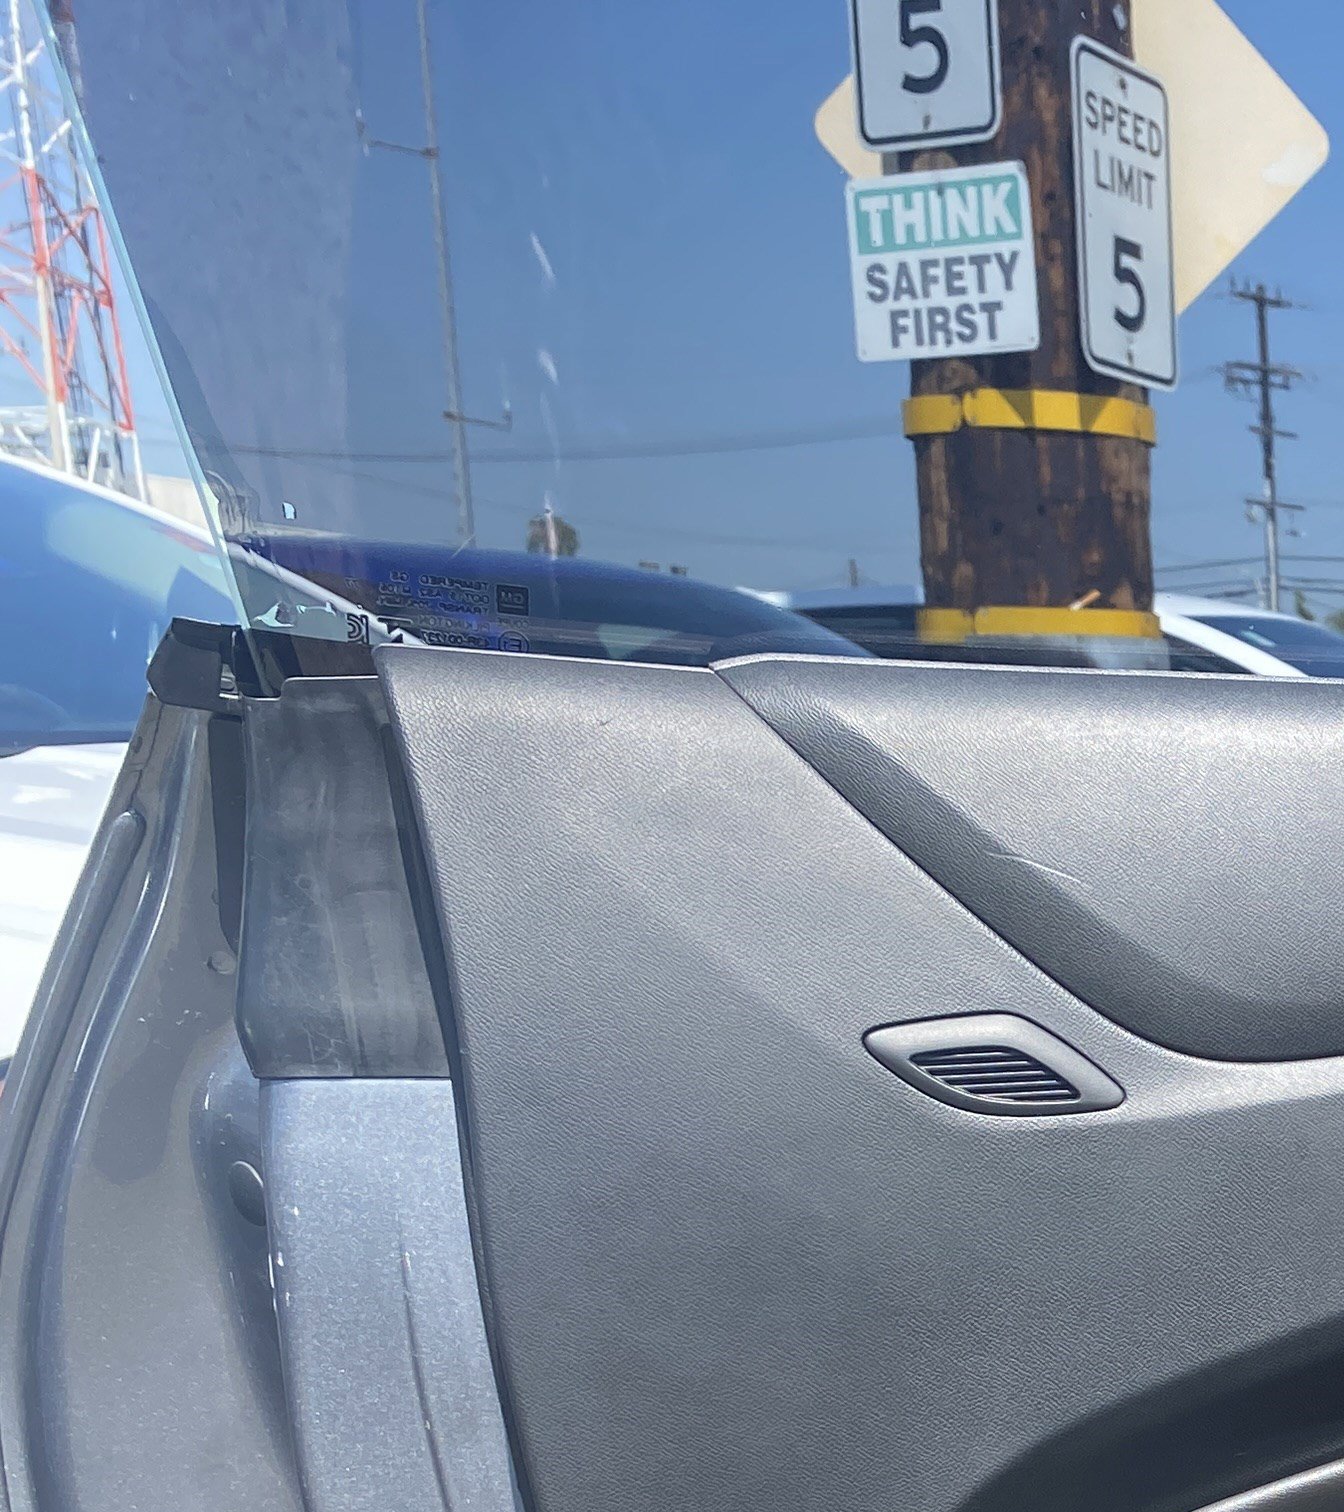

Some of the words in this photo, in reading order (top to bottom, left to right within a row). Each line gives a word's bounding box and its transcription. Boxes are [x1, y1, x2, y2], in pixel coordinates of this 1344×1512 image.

[900, 0, 949, 94] 5
[1085, 91, 1162, 159] SPEED
[1093, 149, 1157, 210] LIMIT
[860, 182, 1018, 247] THINK
[865, 250, 1020, 304] SAFETY
[1112, 236, 1146, 334] 5
[889, 301, 1004, 349] FIRST
